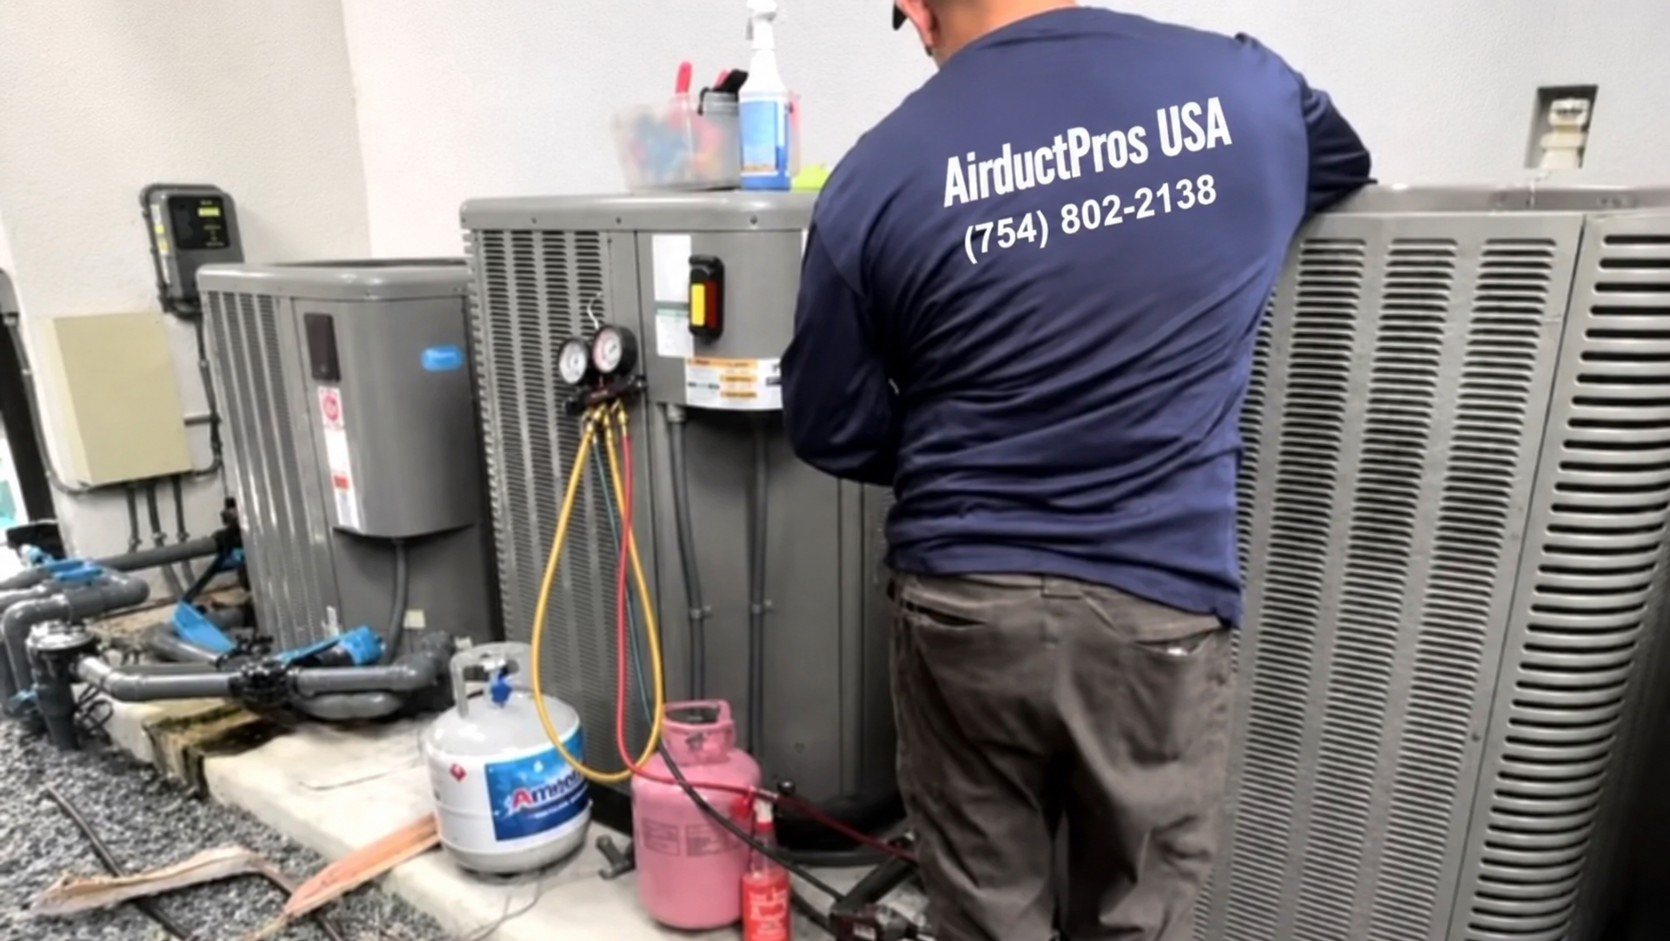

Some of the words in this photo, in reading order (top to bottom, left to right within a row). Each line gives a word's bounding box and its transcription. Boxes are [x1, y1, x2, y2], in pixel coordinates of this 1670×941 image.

[943, 126, 1149, 208] AirductPros
[1156, 96, 1233, 157] USA
[964, 210, 1049, 265] (754)
[1060, 174, 1217, 234] 802-2138
